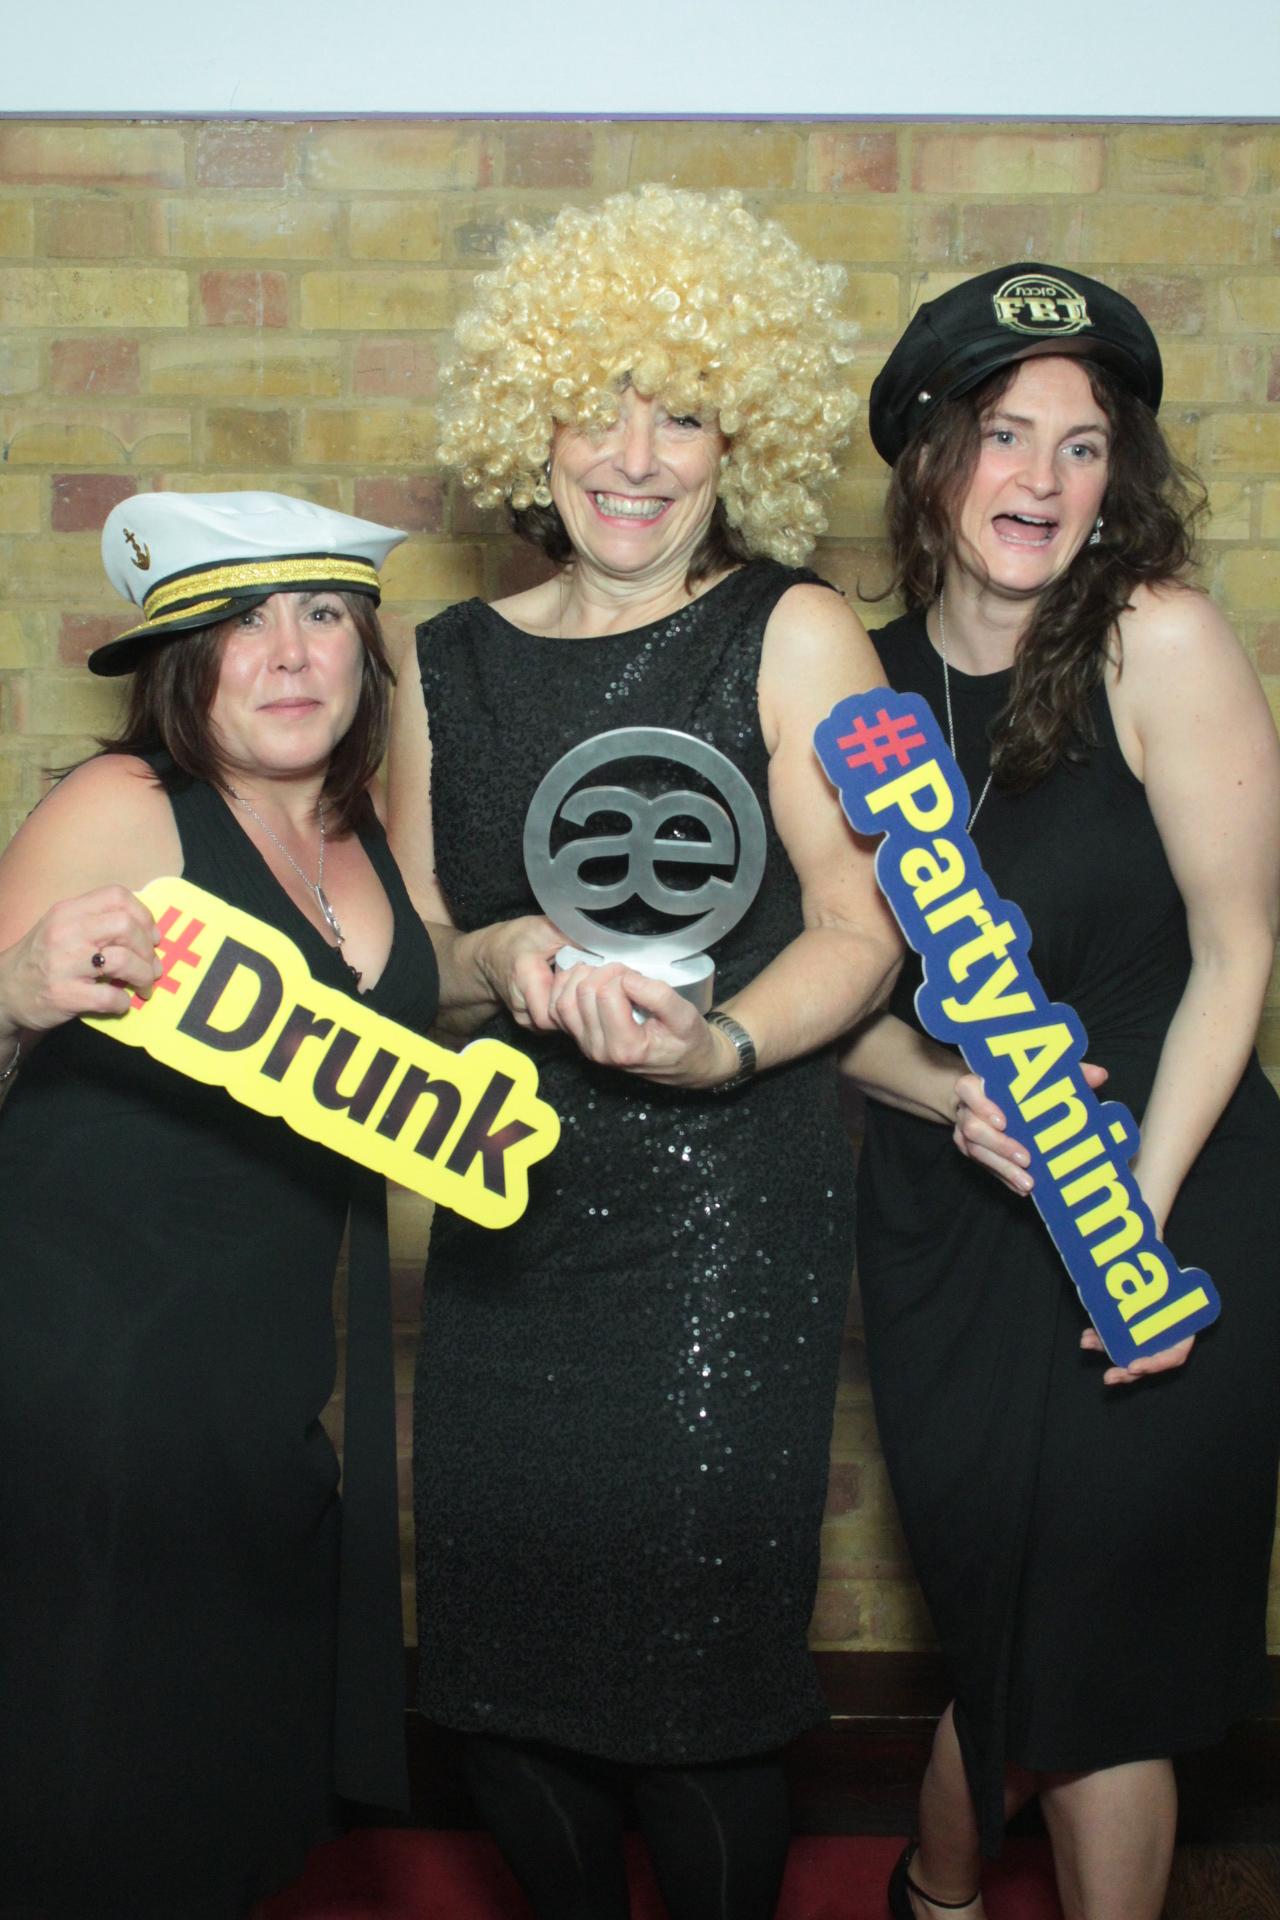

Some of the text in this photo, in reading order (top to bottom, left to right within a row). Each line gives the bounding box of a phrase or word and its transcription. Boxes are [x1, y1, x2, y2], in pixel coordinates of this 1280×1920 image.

[997, 297, 1085, 322] FBI
[130, 905, 538, 1199] #Drunk
[836, 708, 1210, 1347] #PartyAnimal
